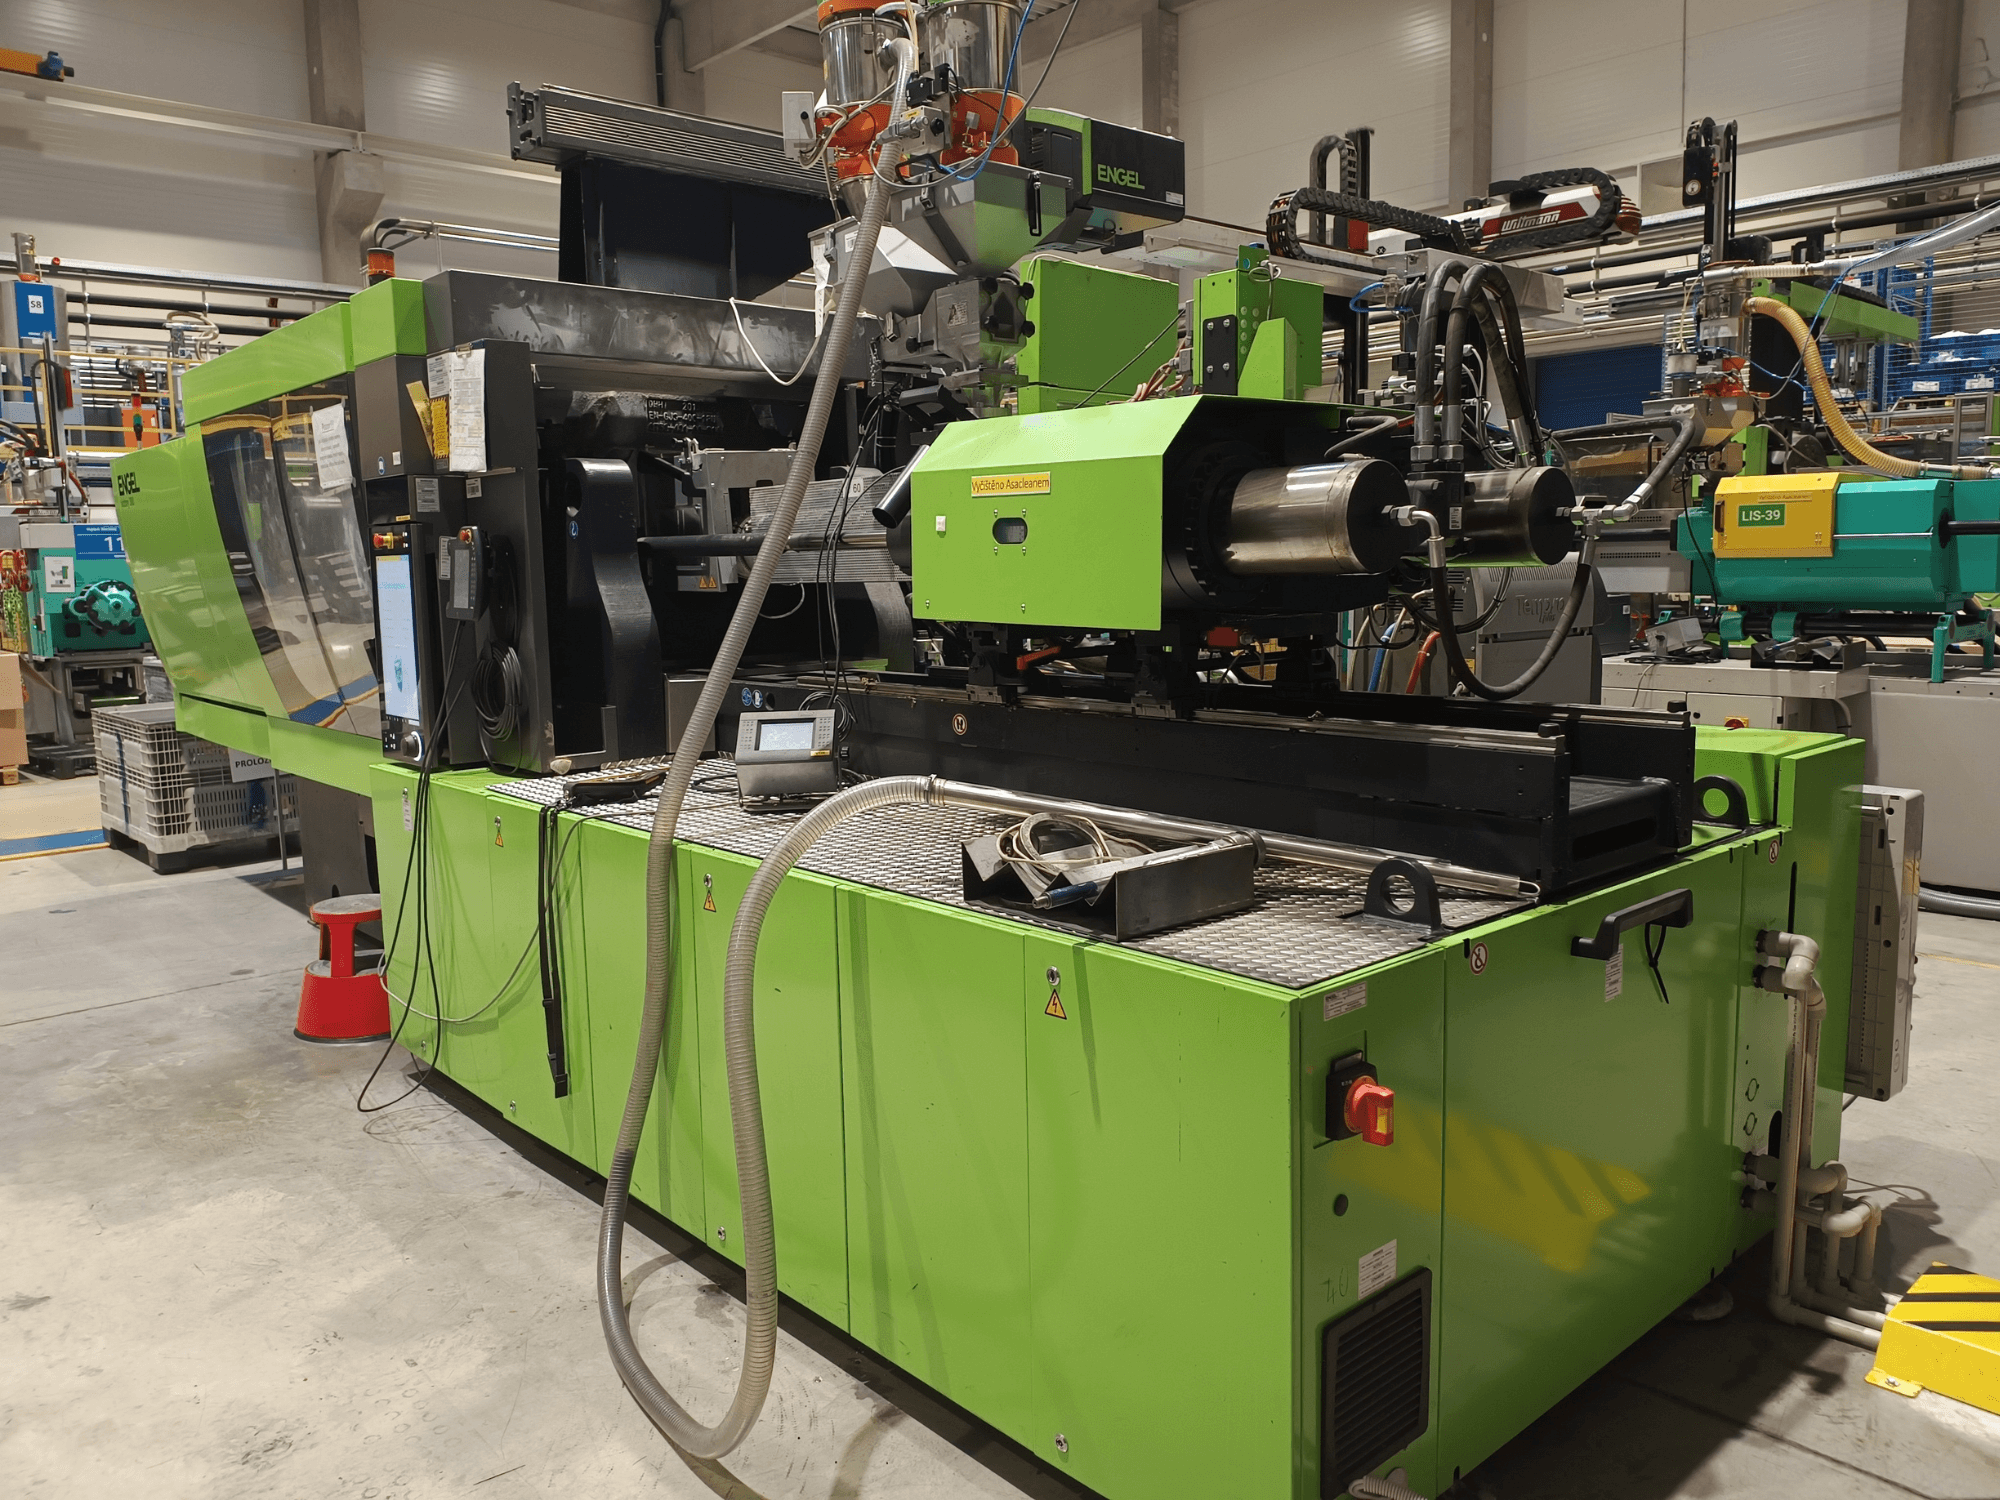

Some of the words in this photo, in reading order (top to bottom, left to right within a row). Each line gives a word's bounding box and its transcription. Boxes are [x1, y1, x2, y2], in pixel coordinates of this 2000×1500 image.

[1097, 163, 1146, 190] ENGEL
[30, 300, 42, 309] S8
[117, 471, 141, 497] ENGEL
[852, 483, 861, 494] 60
[971, 479, 1005, 493] Vyčištěno
[1005, 477, 1050, 490] Asacleanem
[1741, 509, 1781, 522] LIS-39
